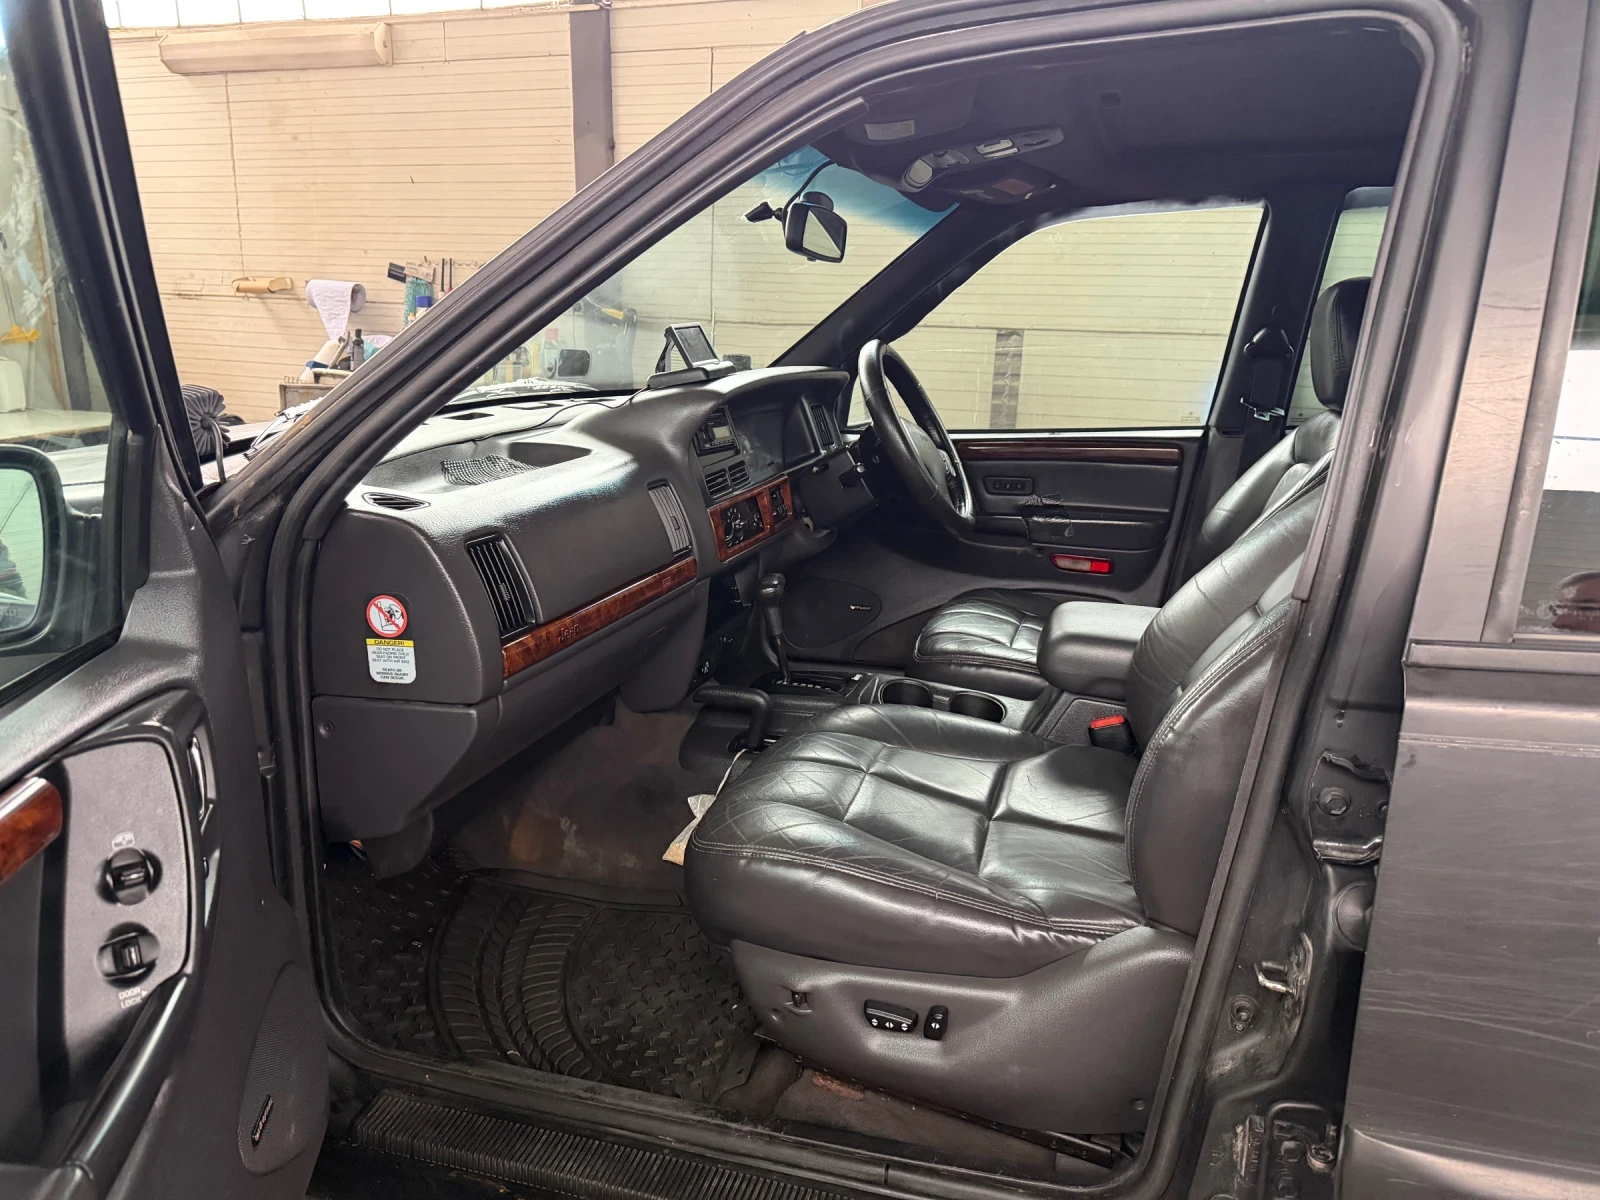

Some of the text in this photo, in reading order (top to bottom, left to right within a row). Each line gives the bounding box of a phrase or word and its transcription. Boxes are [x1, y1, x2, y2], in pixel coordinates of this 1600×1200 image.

[558, 624, 579, 641] Jeep
[118, 987, 140, 1000] DOOR
[121, 996, 142, 1008] LOCK
